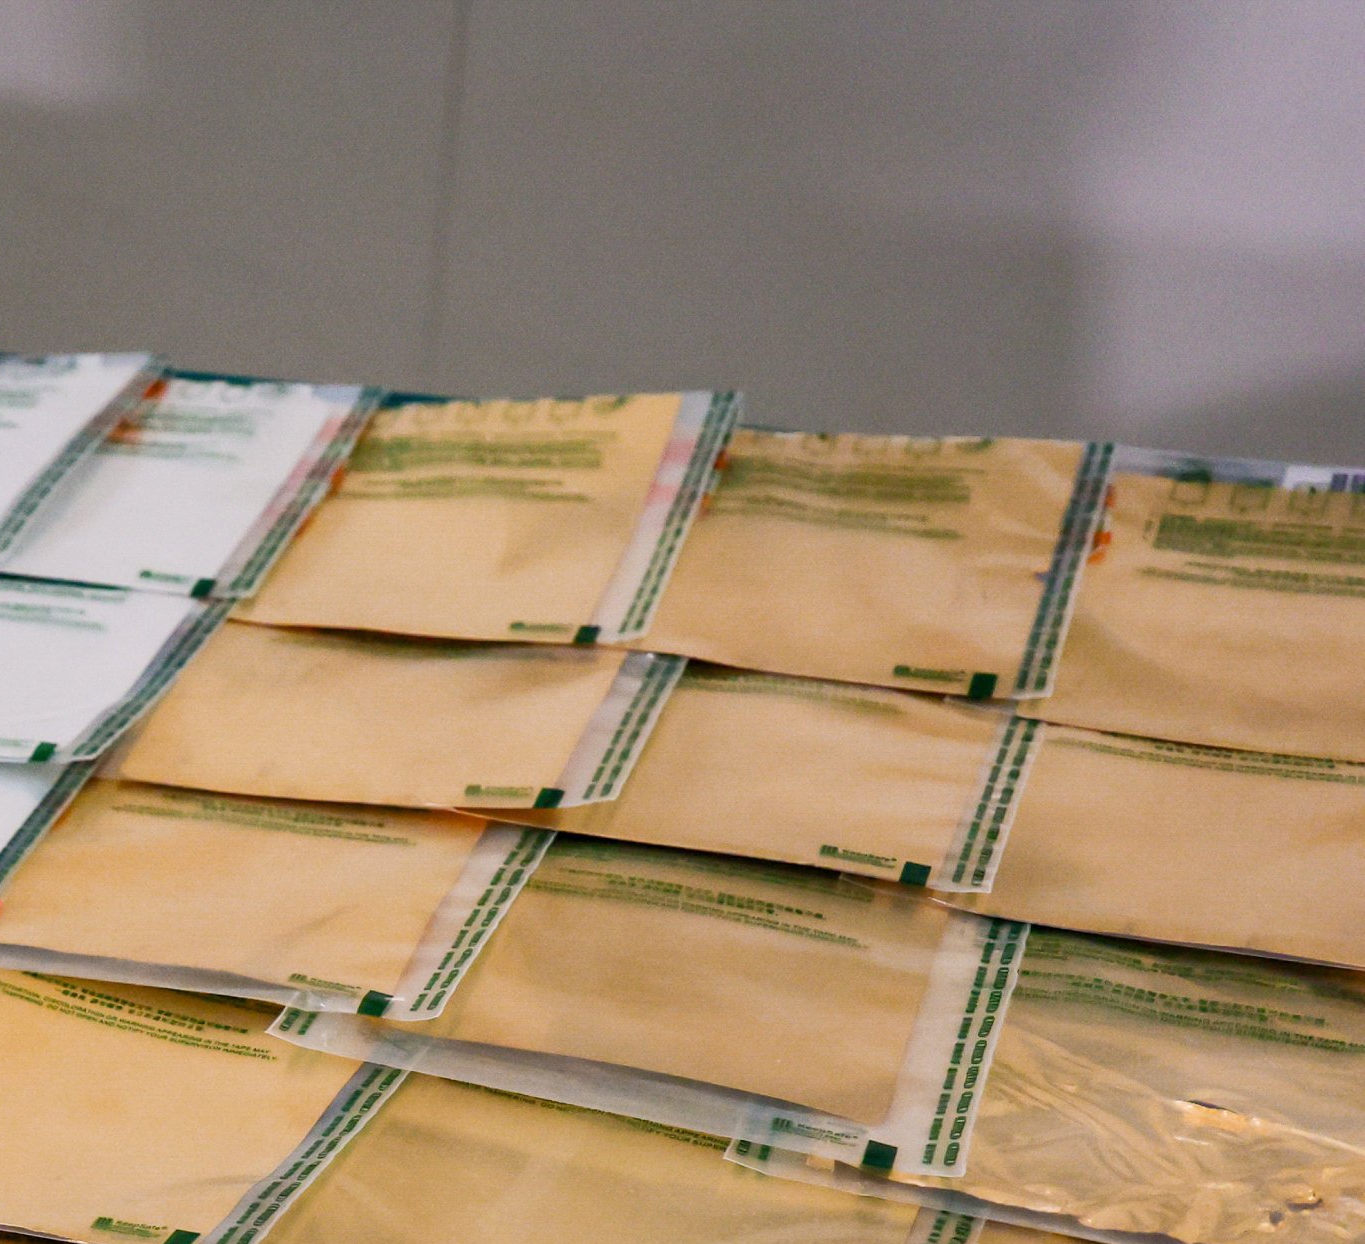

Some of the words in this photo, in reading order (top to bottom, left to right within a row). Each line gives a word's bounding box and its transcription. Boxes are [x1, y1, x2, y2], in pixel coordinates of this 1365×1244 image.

[99, 1018, 115, 1027] AND
[145, 1031, 168, 1041] YOUR
[158, 1028, 202, 1042] APPEARING
[215, 1040, 229, 1048] THE
[232, 1043, 251, 1051] TAPE
